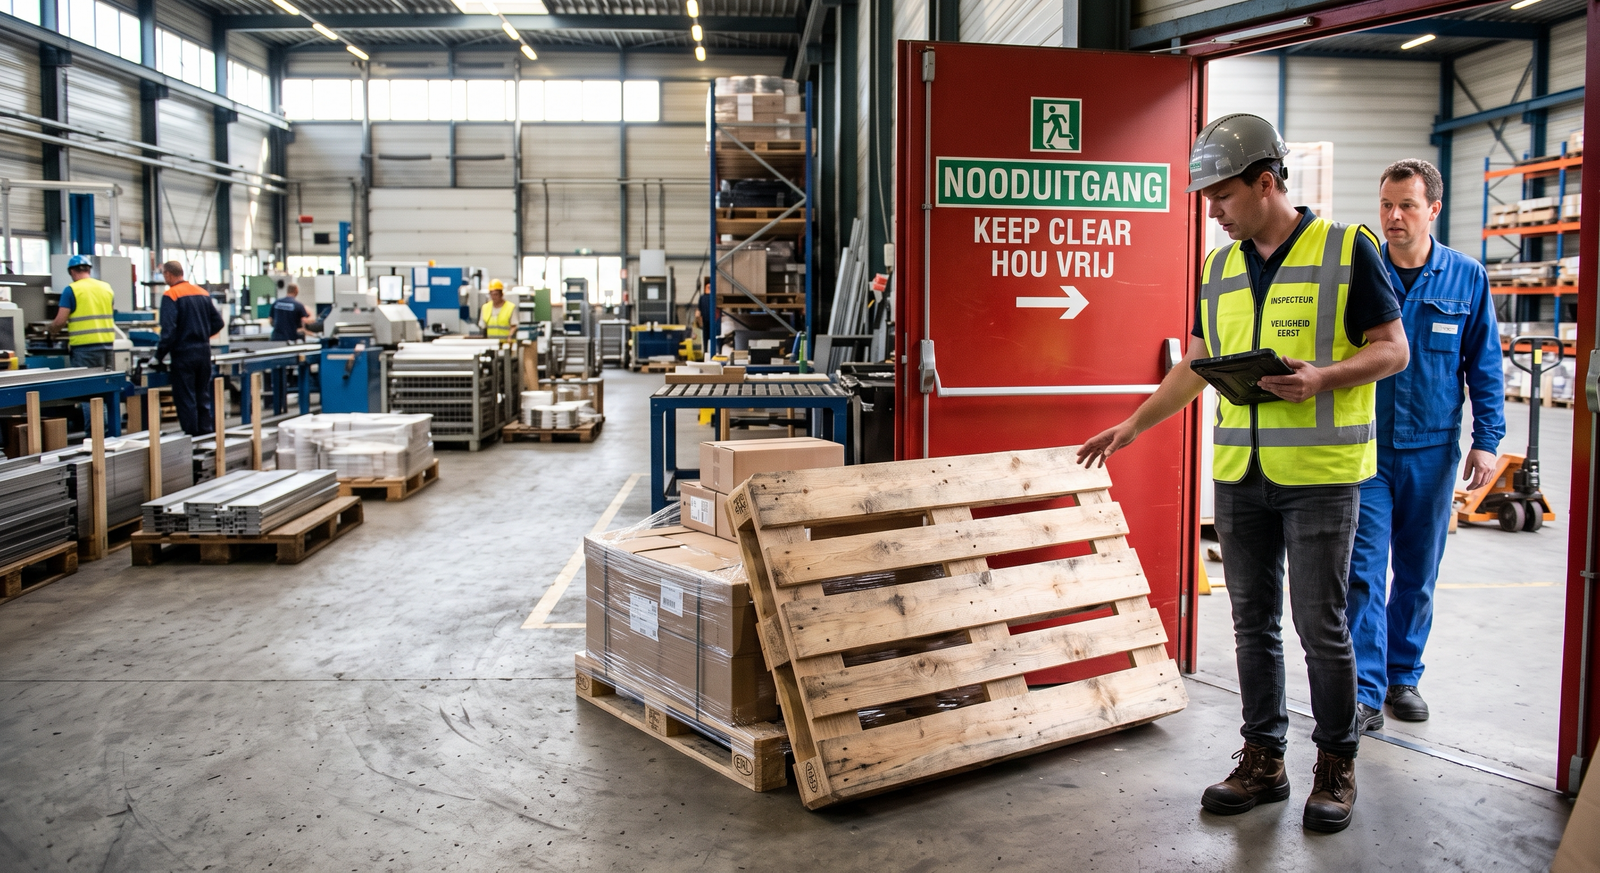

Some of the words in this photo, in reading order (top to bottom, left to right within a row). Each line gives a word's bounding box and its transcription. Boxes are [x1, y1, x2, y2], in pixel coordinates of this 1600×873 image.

[944, 167, 1162, 203] NOODUITGANG
[974, 216, 1040, 244] KEEP
[1049, 218, 1132, 246] CLEAR
[991, 250, 1048, 277] HOU
[1056, 251, 1115, 278] VRIJ
[1270, 296, 1314, 305] INSPECTEUR
[1270, 319, 1310, 328] VEILIGHEID
[1277, 329, 1301, 337] EERST
